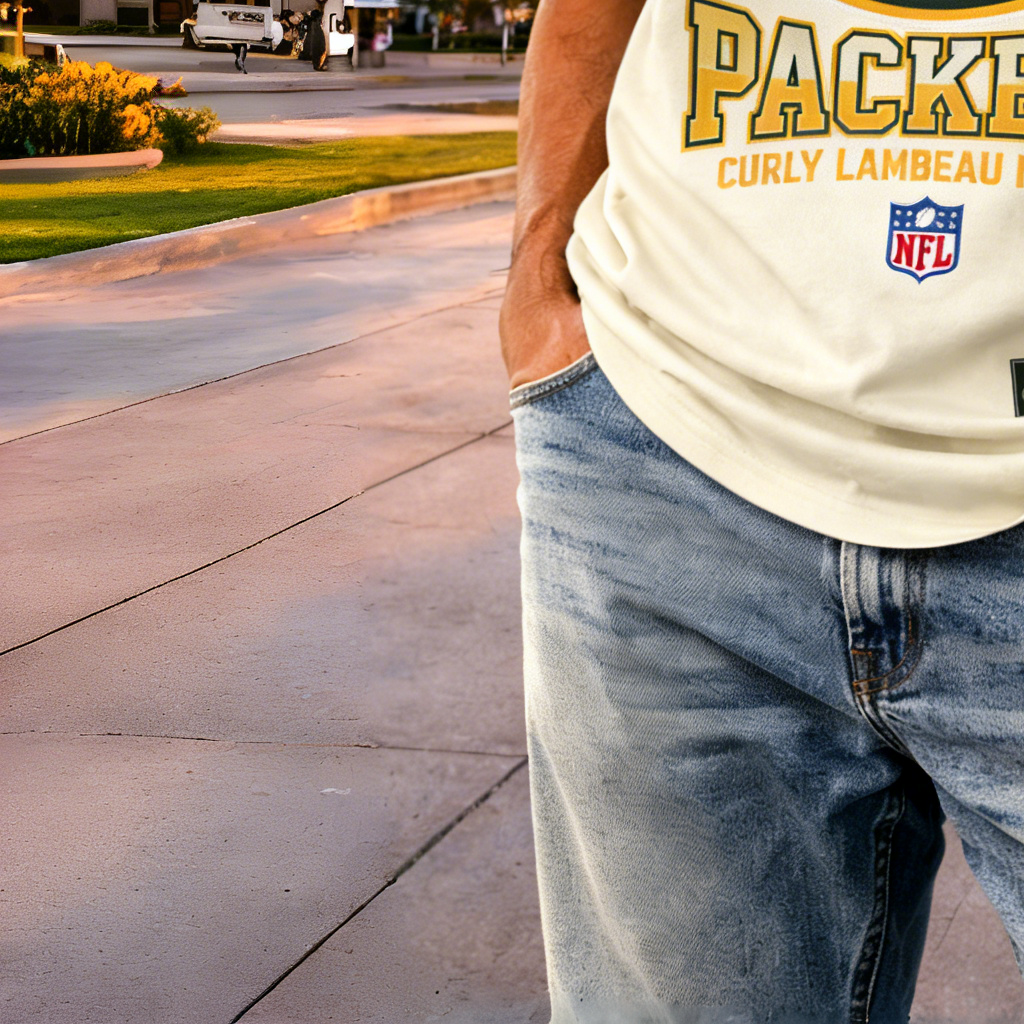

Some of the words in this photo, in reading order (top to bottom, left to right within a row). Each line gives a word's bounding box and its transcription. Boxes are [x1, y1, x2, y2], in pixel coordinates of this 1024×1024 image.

[717, 148, 824, 189] CURLY
[835, 148, 1004, 186] LAMBEAU
[891, 233, 954, 271] NFL
